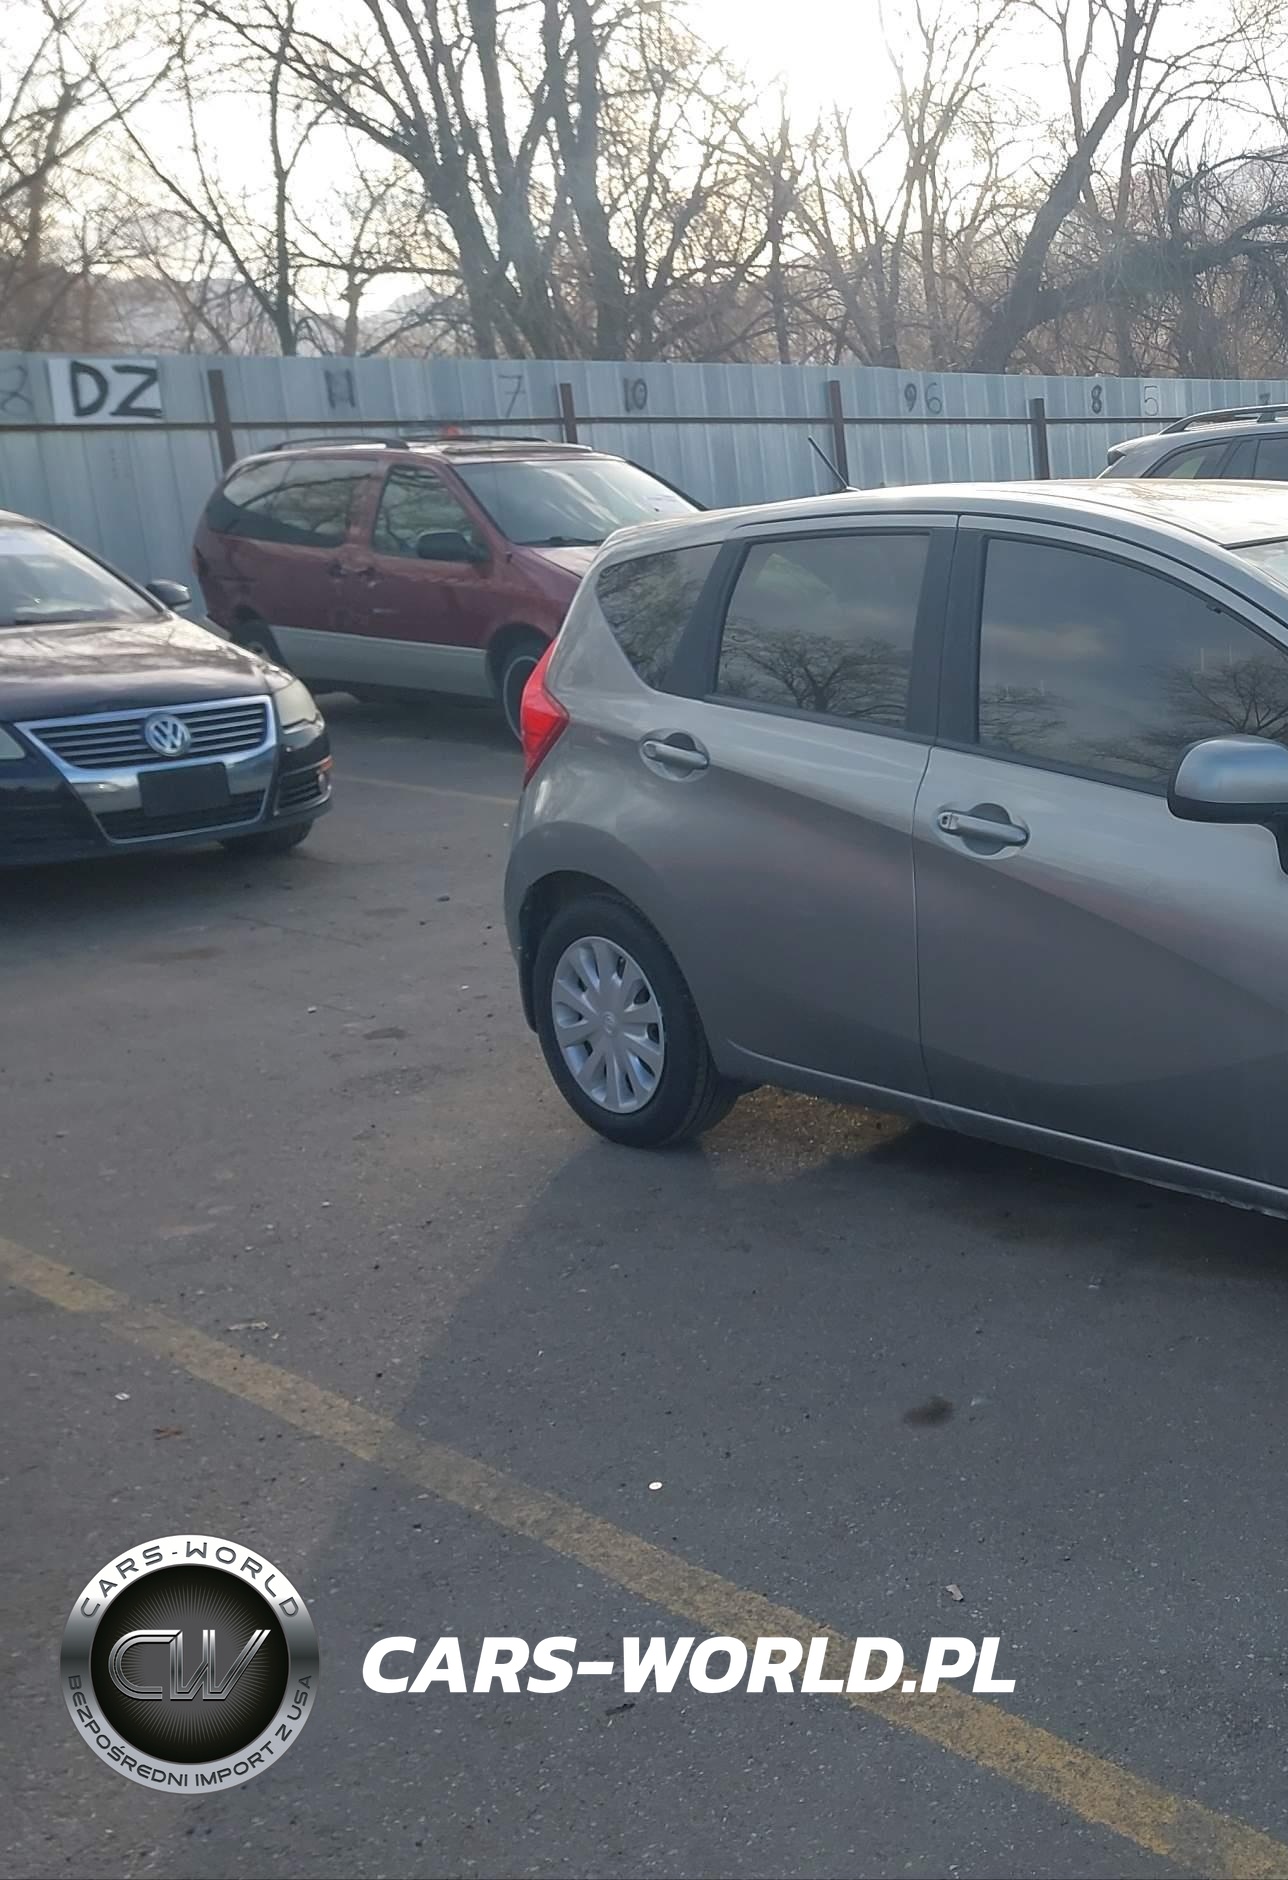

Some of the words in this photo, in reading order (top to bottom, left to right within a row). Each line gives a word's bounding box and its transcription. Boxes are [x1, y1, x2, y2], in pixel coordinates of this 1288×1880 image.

[70, 360, 162, 418] DZ
[500, 374, 525, 417] 7
[623, 377, 648, 413] 10
